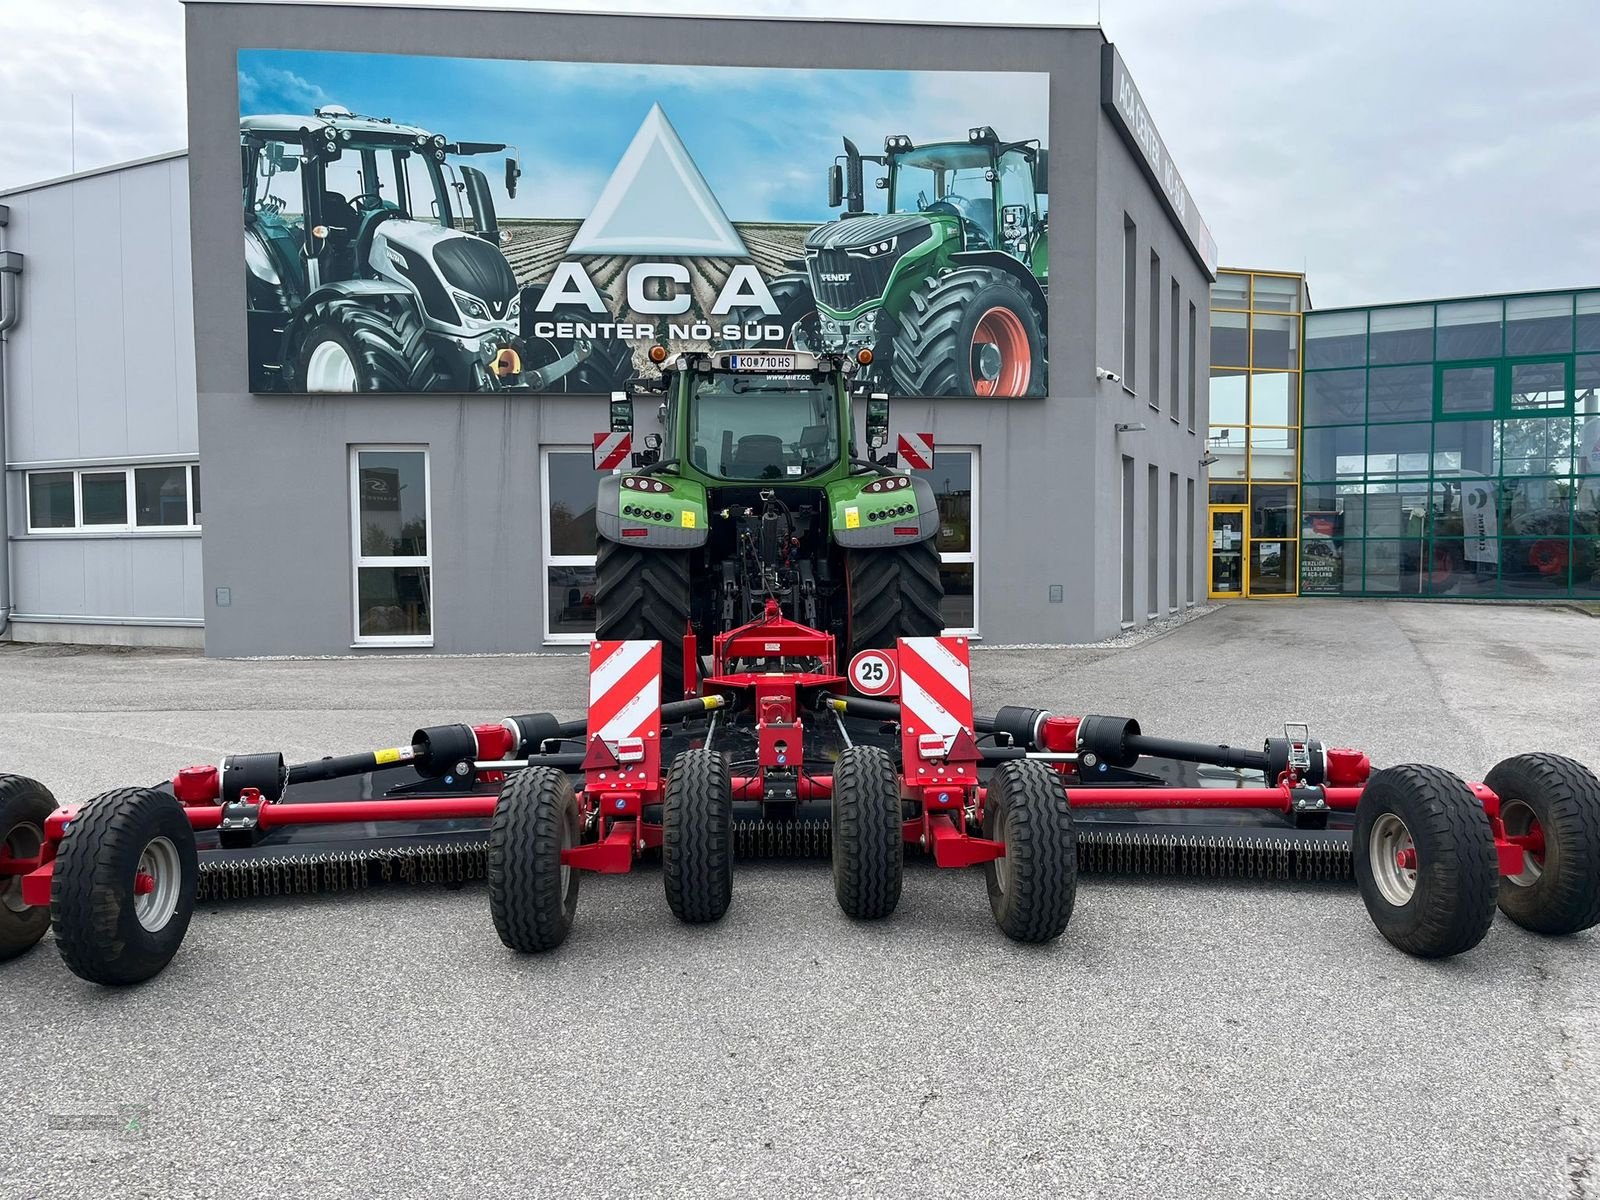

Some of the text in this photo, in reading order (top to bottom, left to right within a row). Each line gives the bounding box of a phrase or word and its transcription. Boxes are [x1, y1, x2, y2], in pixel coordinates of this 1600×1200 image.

[1120, 73, 1135, 126] ACA
[1136, 103, 1160, 172] CENTER
[820, 273, 852, 281] FENDT
[535, 261, 782, 316] ACA
[534, 320, 785, 341] CENTER NÖ-SÜD
[740, 357, 752, 367] KO
[862, 662, 884, 680] 25
